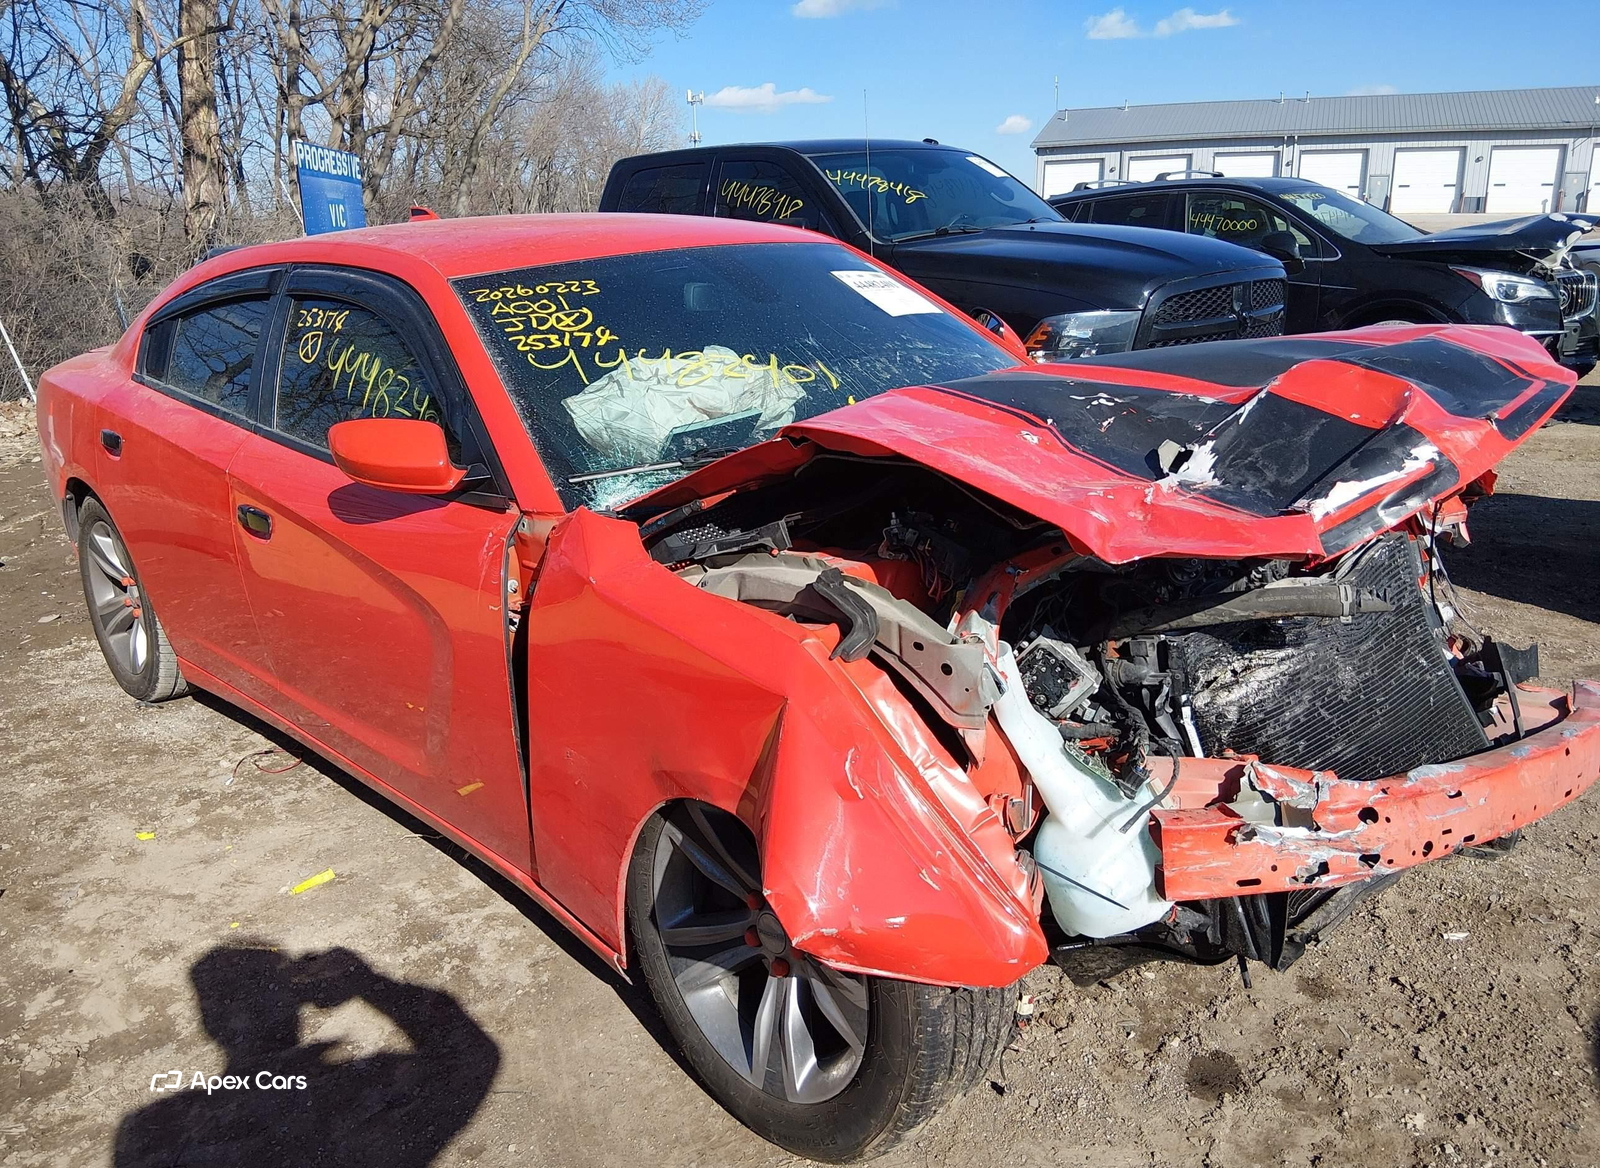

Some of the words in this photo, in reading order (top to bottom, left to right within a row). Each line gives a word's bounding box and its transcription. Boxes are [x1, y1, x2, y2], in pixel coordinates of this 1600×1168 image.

[296, 143, 362, 180] PROGRESSIVE
[329, 203, 346, 228] VIC
[1190, 212, 1258, 231] 44470000
[469, 280, 601, 302] 20260223
[491, 295, 570, 315] A001
